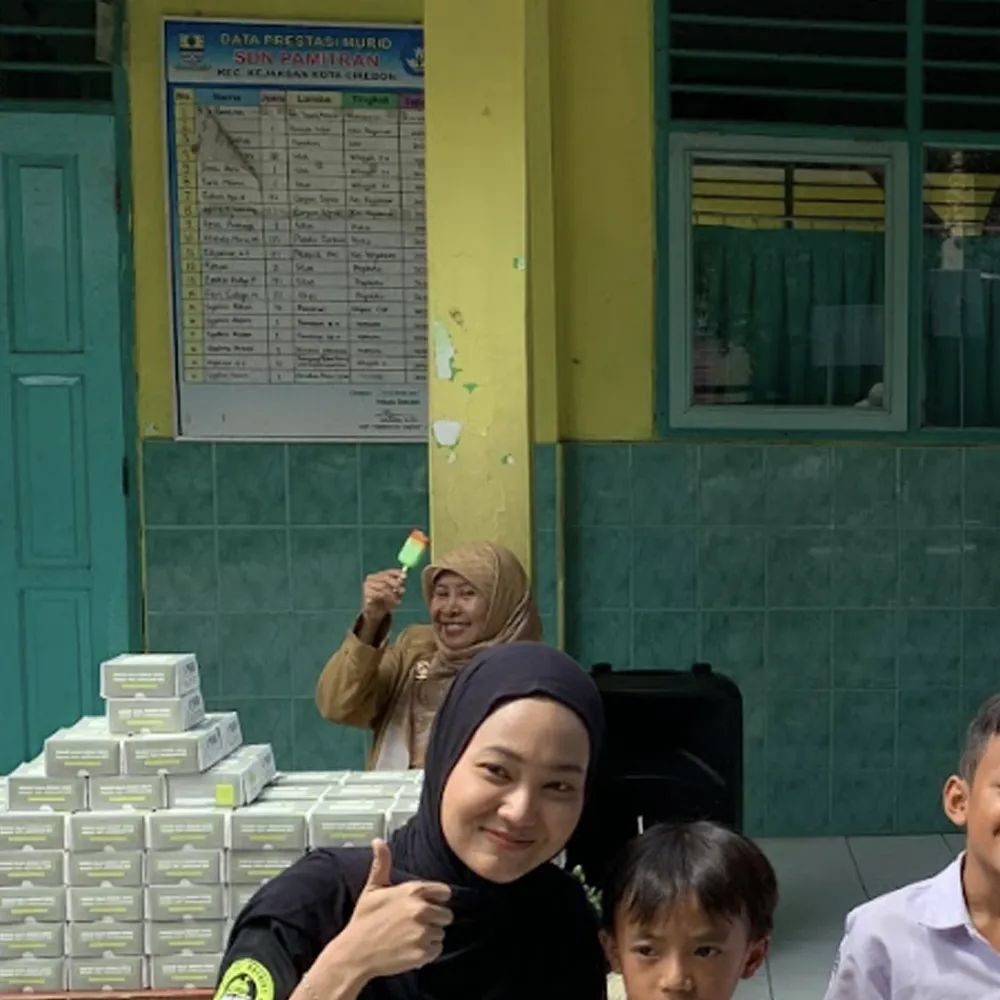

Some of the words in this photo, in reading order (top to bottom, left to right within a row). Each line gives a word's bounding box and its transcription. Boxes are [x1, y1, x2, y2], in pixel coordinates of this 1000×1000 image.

[220, 33, 260, 45] DATA
[263, 35, 340, 48] PRESTASI
[342, 37, 393, 49] MURID
[234, 51, 273, 65] SDN
[280, 52, 380, 67] PAMITRAN
